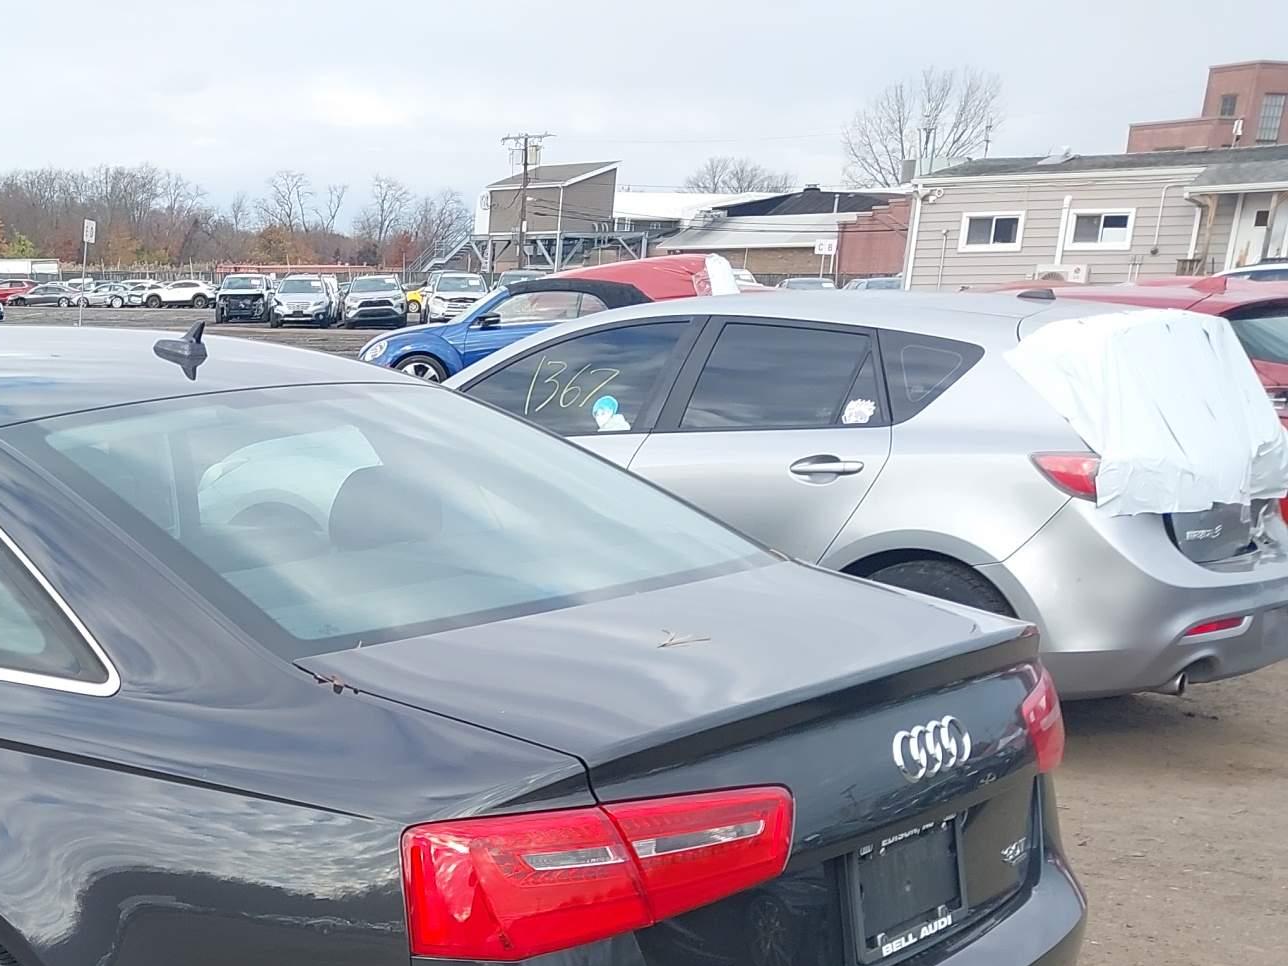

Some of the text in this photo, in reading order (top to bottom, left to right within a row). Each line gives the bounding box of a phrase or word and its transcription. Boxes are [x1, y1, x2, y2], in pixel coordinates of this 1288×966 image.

[524, 355, 620, 415] 1367
[881, 913, 952, 957] BELL AUDI
